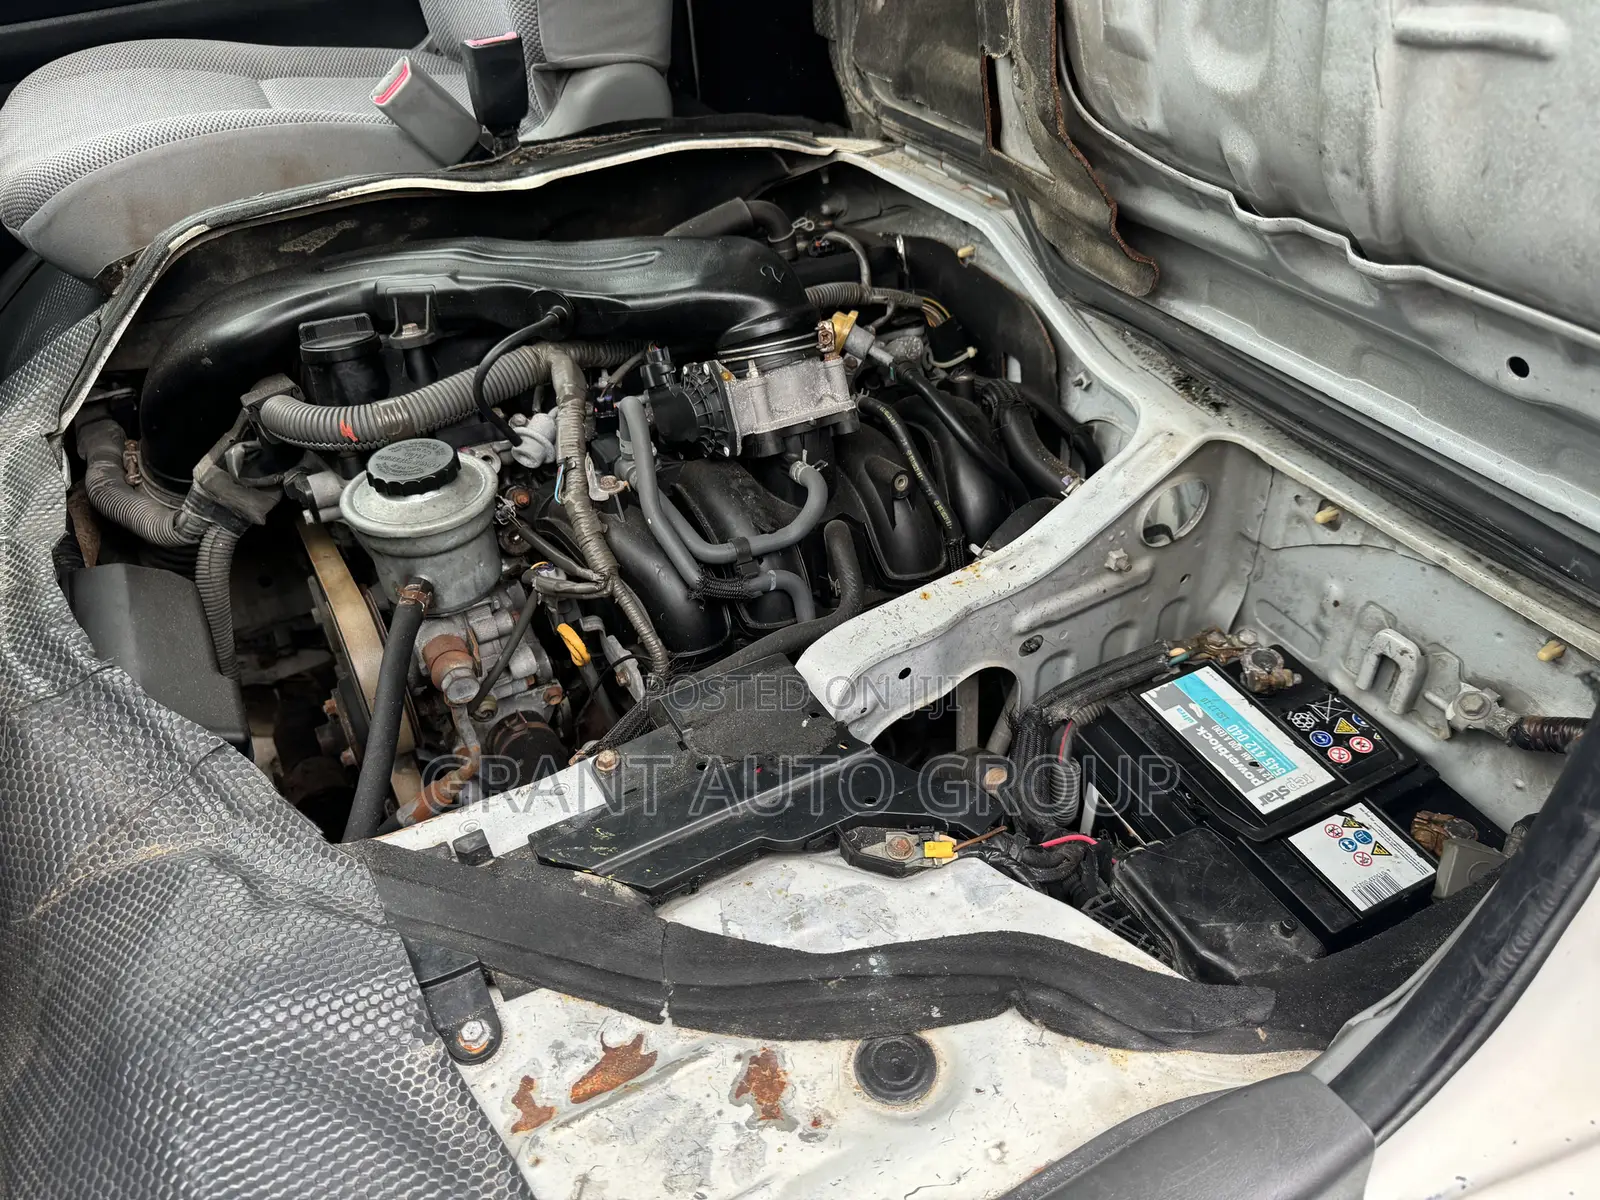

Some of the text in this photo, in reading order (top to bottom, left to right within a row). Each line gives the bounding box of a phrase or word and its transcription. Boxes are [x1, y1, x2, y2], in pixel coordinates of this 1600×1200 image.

[1175, 706, 1196, 724] ultra
[1226, 724, 1250, 743] 040
[1244, 740, 1268, 759] 412
[1262, 757, 1287, 777] 545
